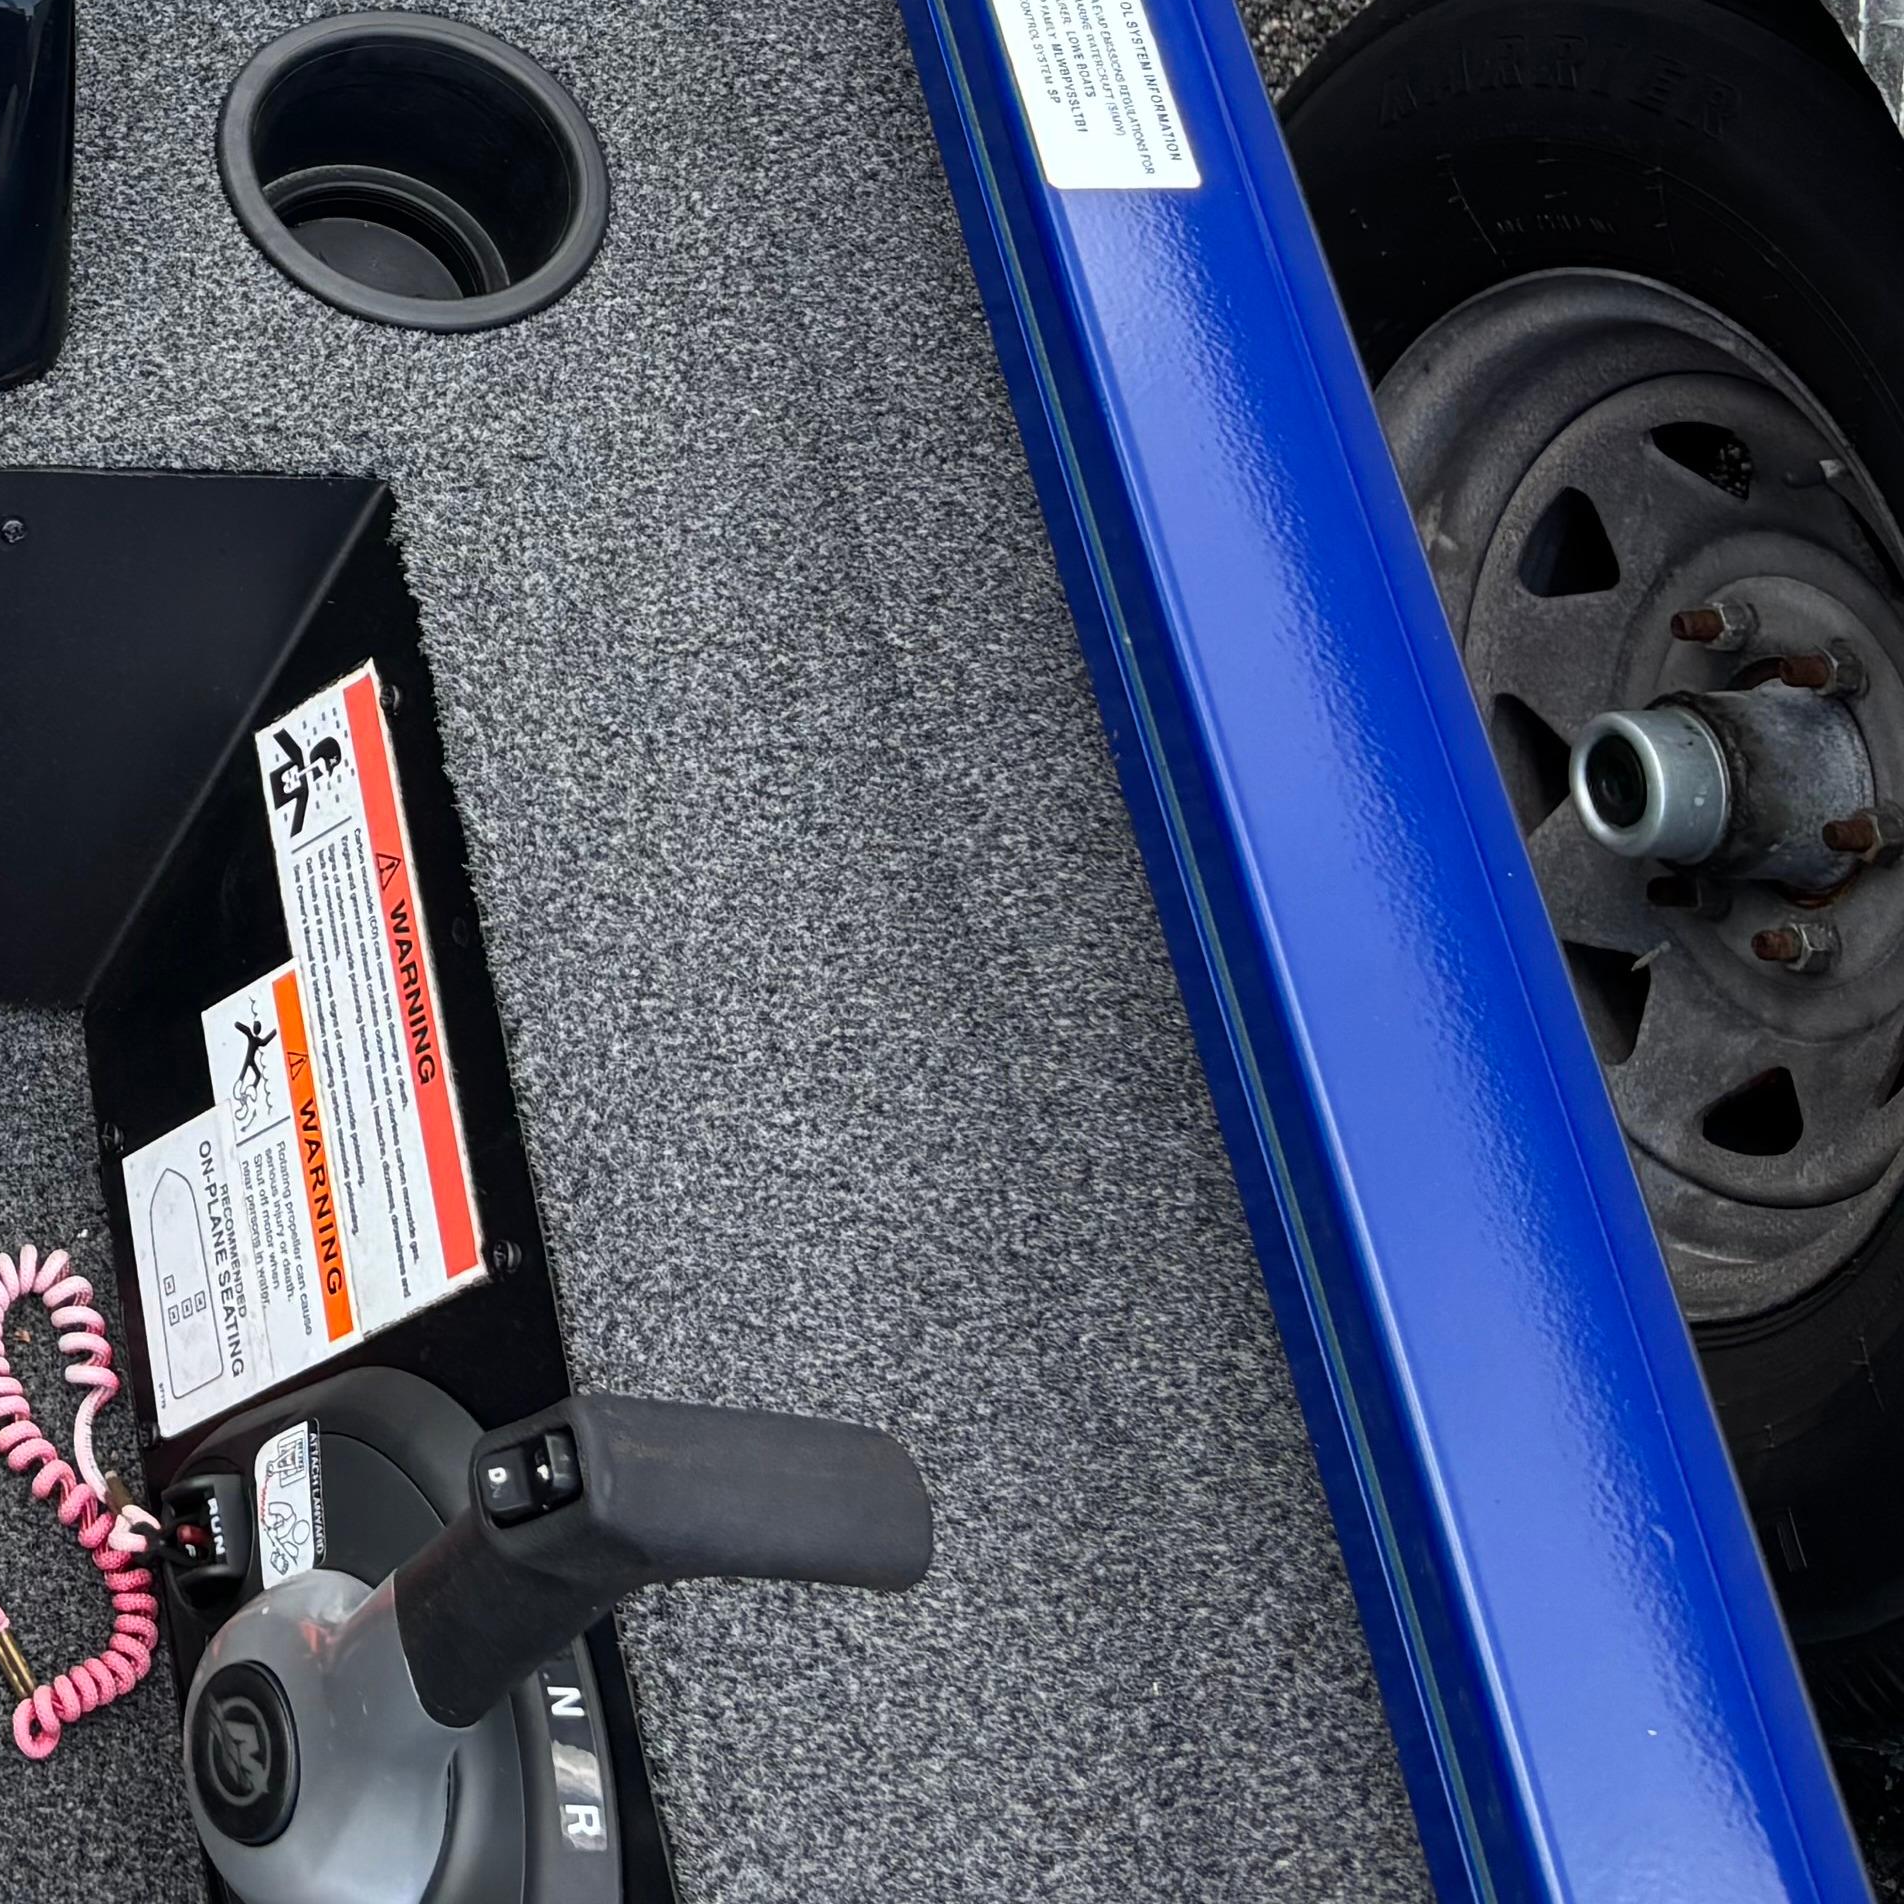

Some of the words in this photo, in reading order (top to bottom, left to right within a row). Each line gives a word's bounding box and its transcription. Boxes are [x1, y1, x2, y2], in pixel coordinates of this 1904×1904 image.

[1065, 30, 1084, 59] LOWE
[1075, 62, 1096, 98] BOATS
[1125, 20, 1152, 70] SYSTEM
[1143, 74, 1182, 160] INFORMATION
[389, 898, 435, 1084] WARNING
[239, 1159, 253, 1190] near
[253, 1152, 265, 1186] Shut
[264, 1147, 278, 1197] serious
[275, 1139, 291, 1199] Rotating
[258, 1188, 269, 1206] off
[272, 1198, 285, 1237] injury
[299, 1097, 342, 1295] WARNING
[243, 1193, 261, 1251] persons
[261, 1208, 274, 1248] motor
[283, 1200, 302, 1260] propeller
[198, 1139, 228, 1266] ON-PLANE
[217, 1269, 244, 1377] SEATING
[215, 1182, 247, 1318] RECOMMENDED
[254, 1249, 264, 1265] in
[279, 1240, 288, 1254] or
[256, 1266, 270, 1311] water.
[268, 1251, 280, 1290] when
[282, 1257, 295, 1302] death.
[295, 1263, 306, 1291] can
[299, 1292, 312, 1336] cause
[309, 1432, 321, 1486] ATTACH
[208, 1497, 226, 1555] RUN
[312, 1488, 326, 1555] LANYARD
[547, 1686, 585, 1717] N
[565, 1804, 601, 1835] R
